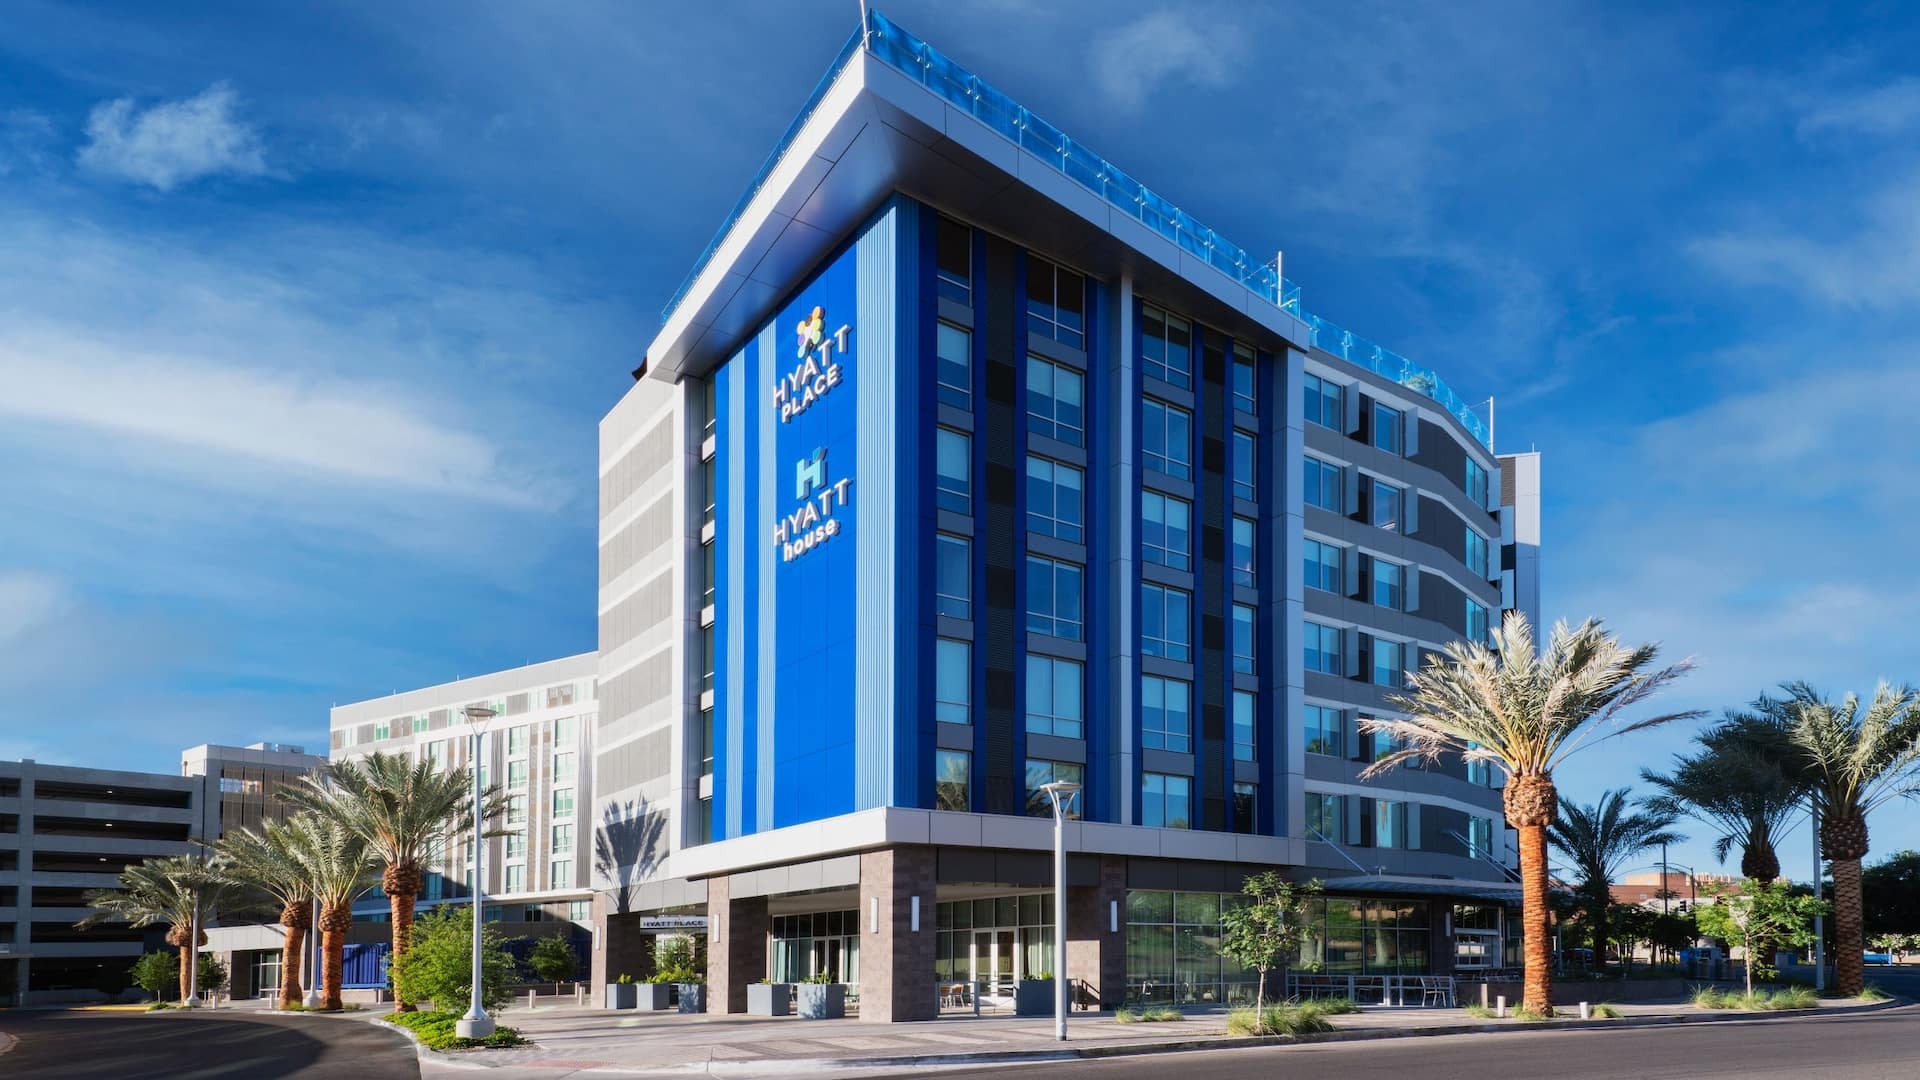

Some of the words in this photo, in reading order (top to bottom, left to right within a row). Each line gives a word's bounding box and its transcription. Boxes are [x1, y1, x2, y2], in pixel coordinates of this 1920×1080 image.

[773, 324, 852, 408] HYATT
[781, 364, 841, 423] PLACE
[773, 478, 852, 546] HYATT
[783, 519, 839, 562] house
